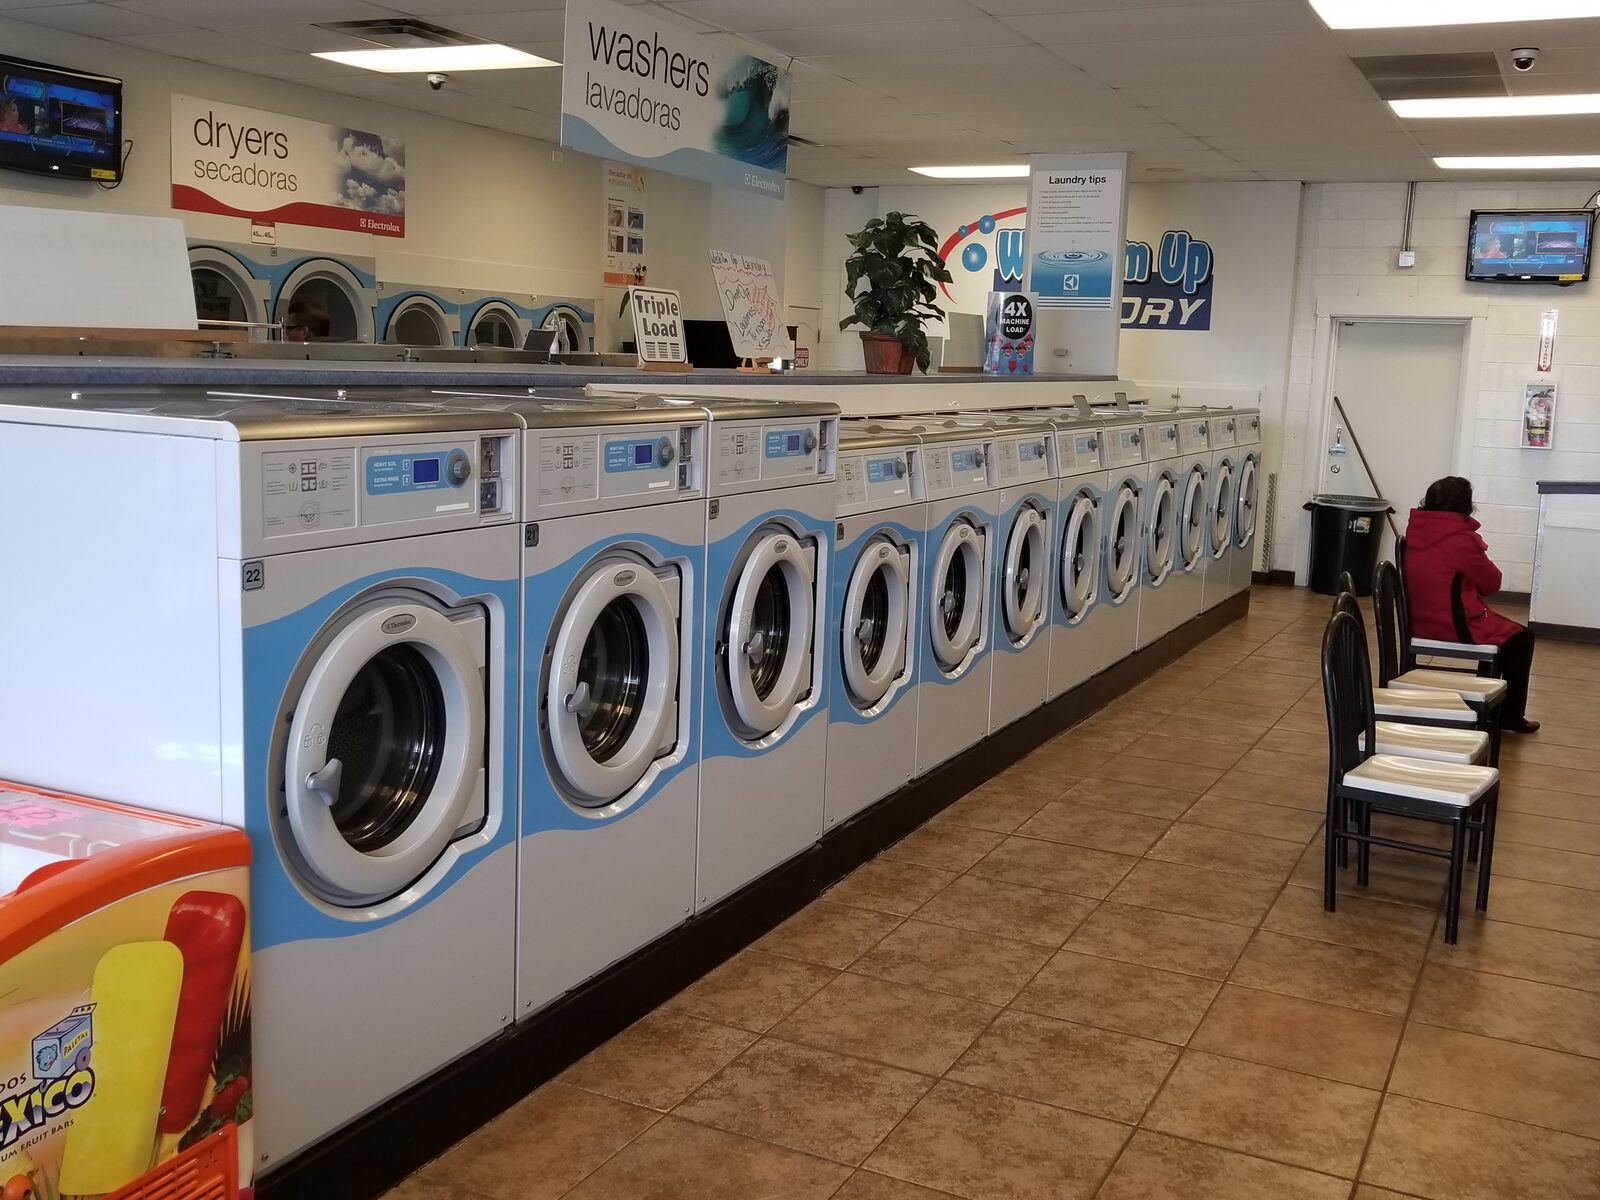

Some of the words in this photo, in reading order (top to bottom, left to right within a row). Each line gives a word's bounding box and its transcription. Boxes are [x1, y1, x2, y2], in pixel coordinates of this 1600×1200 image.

[588, 22, 709, 97] washers
[585, 71, 681, 131] lavadoras
[194, 111, 289, 159] dryers
[193, 159, 298, 192] secadoras
[1048, 176, 1087, 186] Laundry
[1088, 174, 1107, 185] tips
[367, 219, 401, 232] Electrolux
[1158, 230, 1213, 296] Up
[635, 295, 679, 319] Triple
[1004, 302, 1027, 317] 4X
[642, 318, 678, 337] Load
[527, 530, 536, 541] 21
[246, 568, 260, 583] 22
[63, 1031, 89, 1058] PALETAS
[20, 1130, 49, 1152] FRUIT
[51, 1119, 75, 1135] BARS
